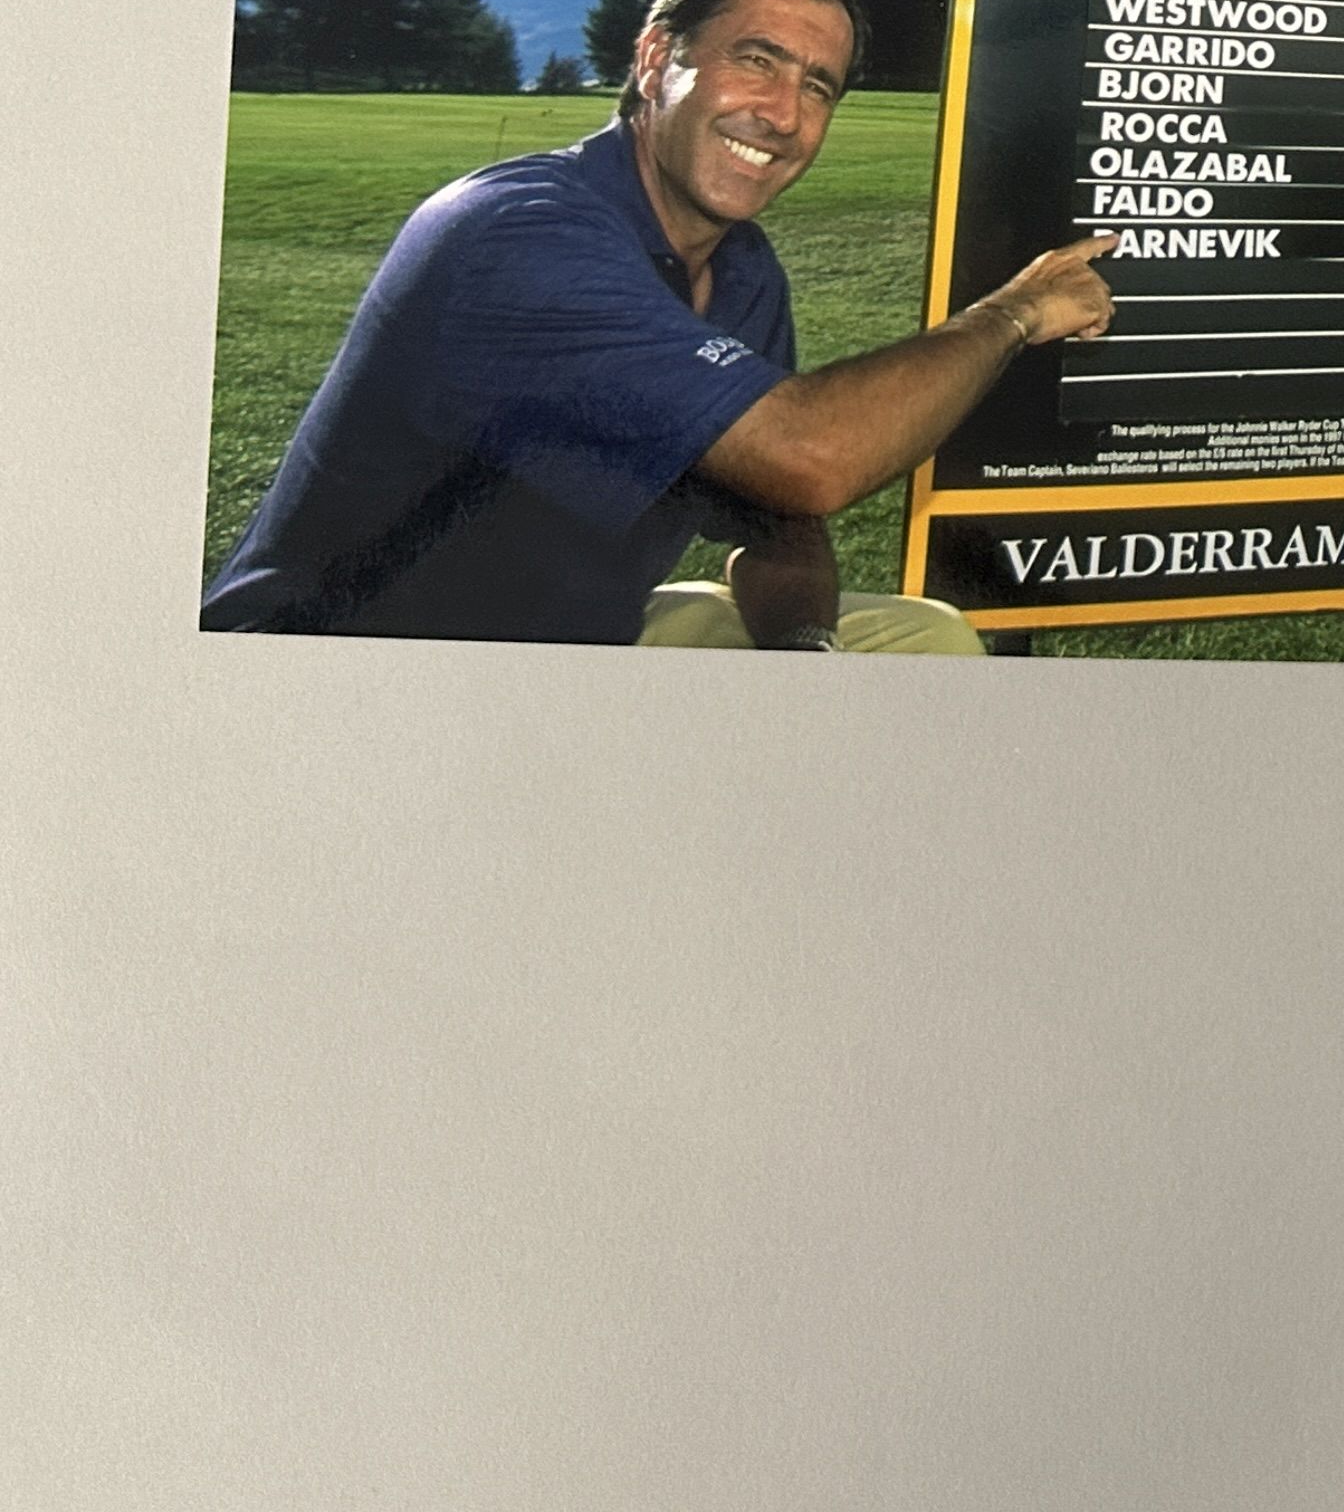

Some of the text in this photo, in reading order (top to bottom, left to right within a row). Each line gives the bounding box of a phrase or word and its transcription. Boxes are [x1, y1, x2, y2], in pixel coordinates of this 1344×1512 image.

[1105, 32, 1275, 68] GARRIDO
[1099, 69, 1223, 104] BJORN
[1101, 112, 1227, 143] ROCCA
[1091, 147, 1291, 182] OLAZABAL
[1094, 185, 1213, 217] FALDO
